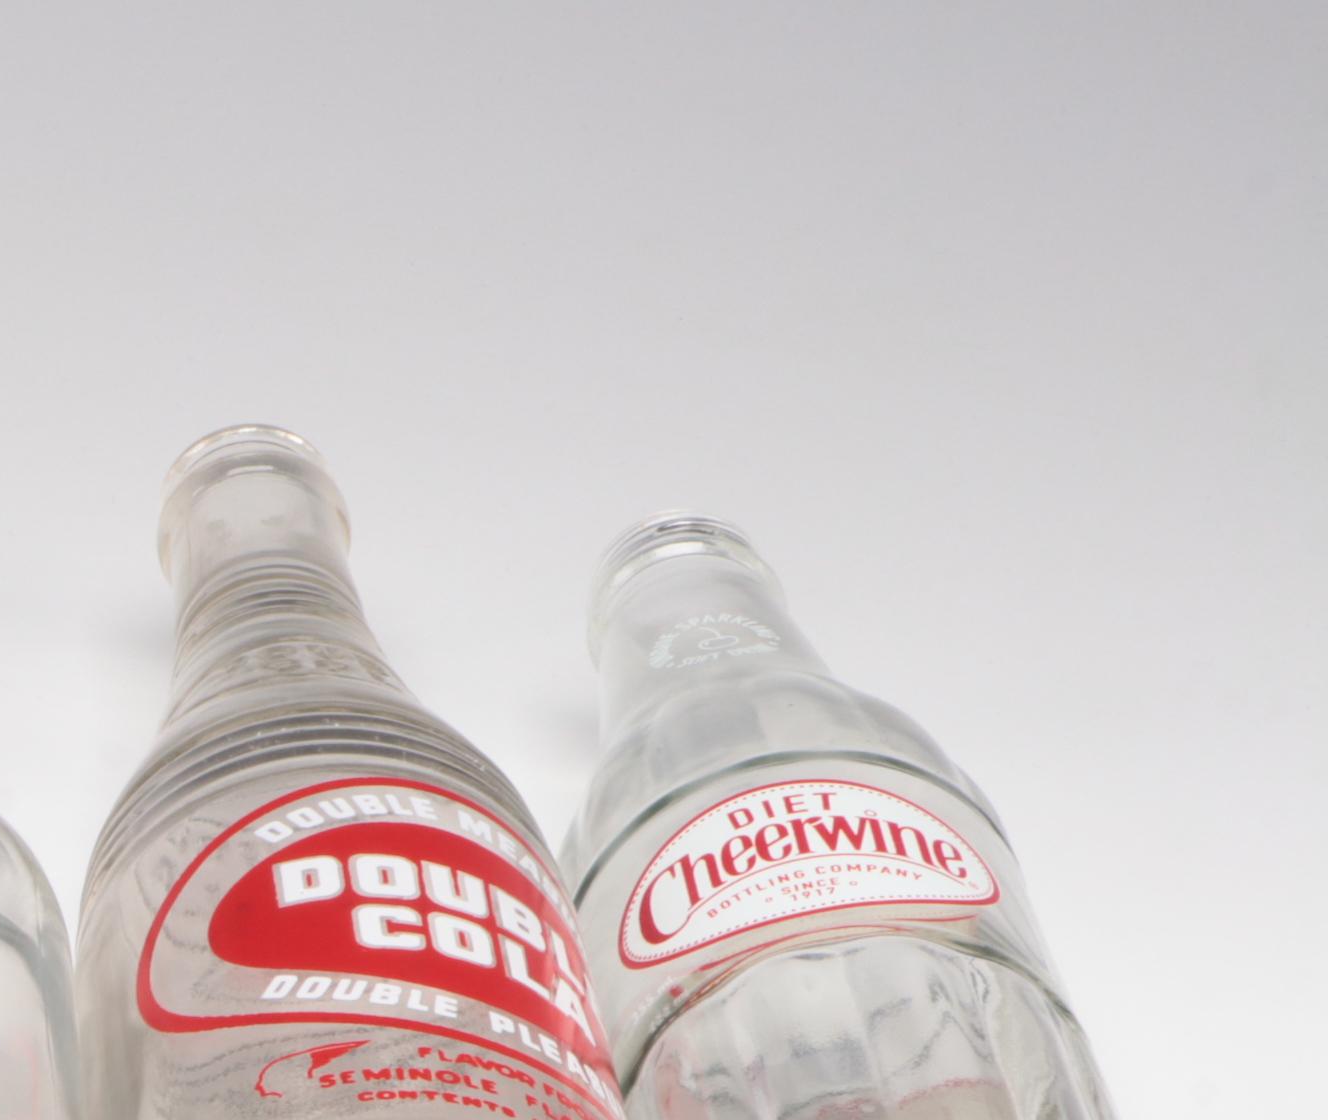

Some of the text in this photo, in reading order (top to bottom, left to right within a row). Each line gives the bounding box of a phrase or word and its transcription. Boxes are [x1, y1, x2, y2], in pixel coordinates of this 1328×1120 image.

[254, 794, 438, 844] DOUBLE
[727, 792, 837, 830] DIET
[639, 810, 968, 944] Cheerwine
[707, 864, 923, 918] BOTTLING COMPANY
[781, 877, 840, 894] SINCE
[791, 887, 836, 901] 1917
[351, 904, 597, 1047] COLA
[261, 975, 459, 1019] DOUBLE
[319, 1066, 499, 1094] SEMINOLE
[418, 1047, 536, 1088] FLAVOR
[357, 1090, 516, 1118] CONTENTS
